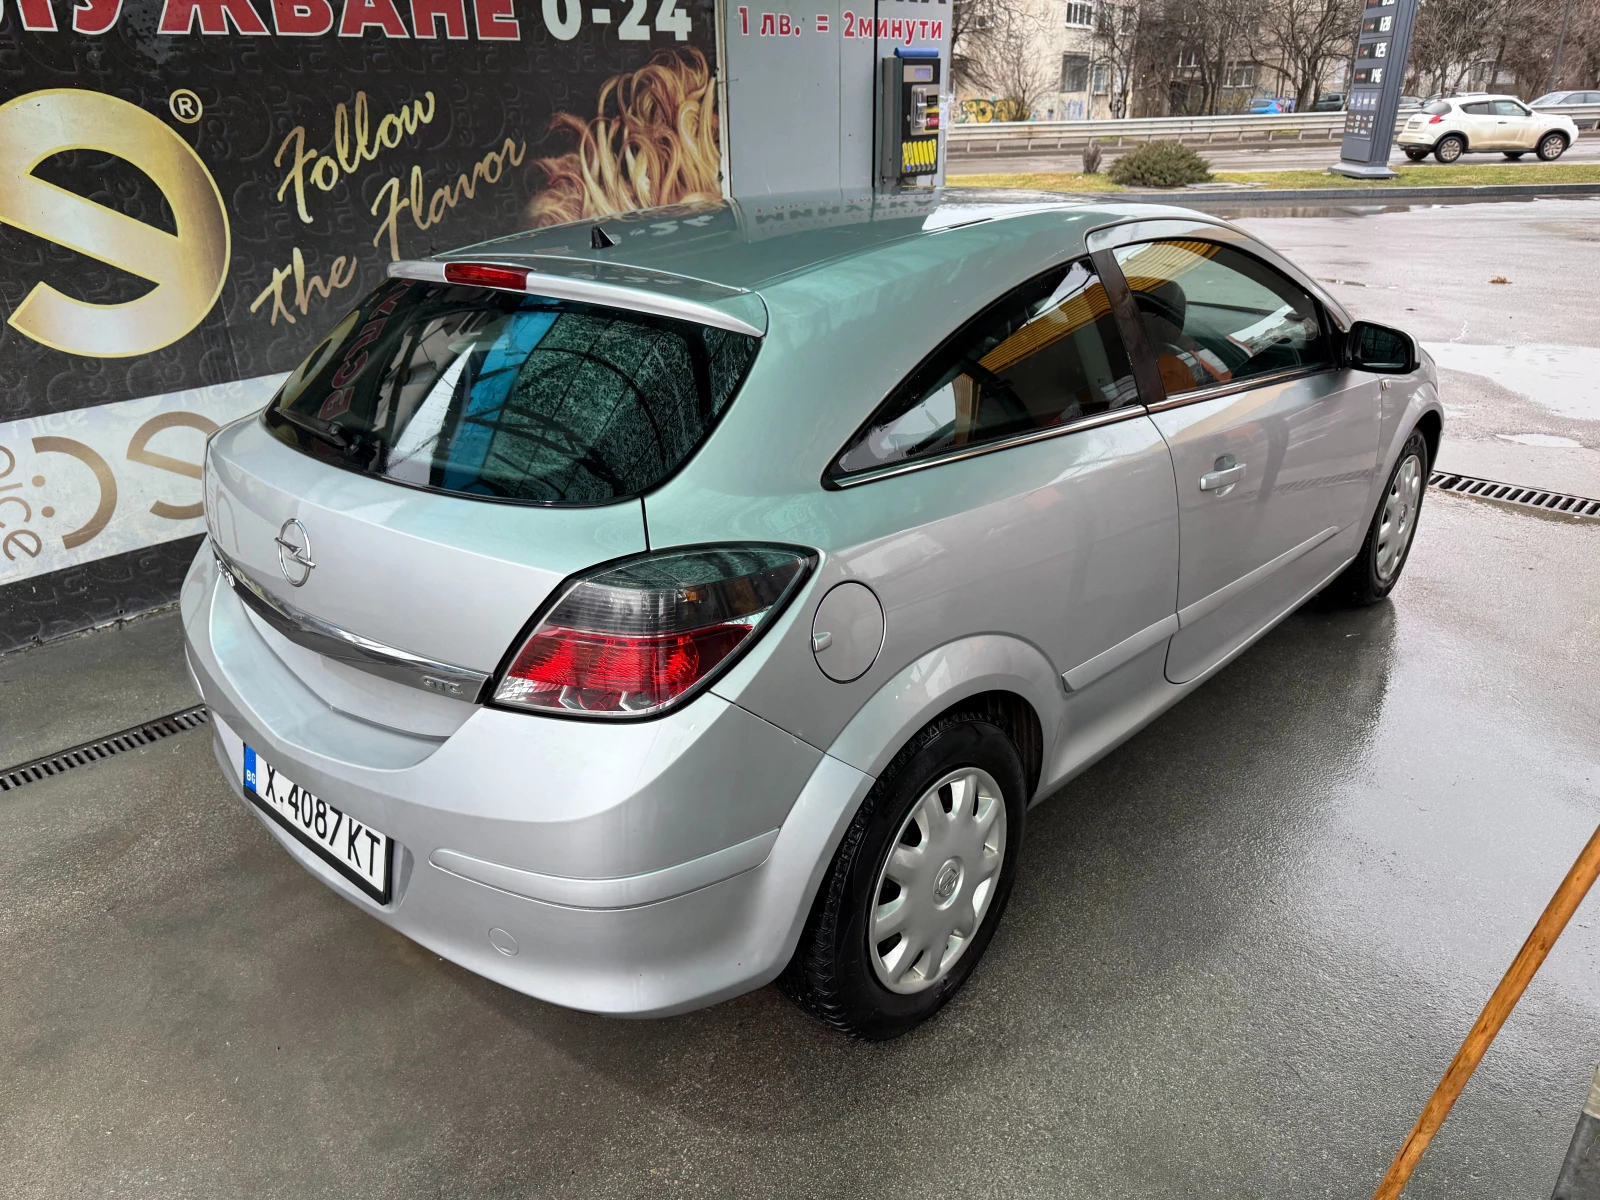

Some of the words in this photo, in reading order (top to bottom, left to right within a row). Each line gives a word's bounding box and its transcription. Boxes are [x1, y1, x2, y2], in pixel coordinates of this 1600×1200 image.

[542, 0, 694, 41] 0-24
[738, 6, 749, 35] 1
[274, 90, 435, 224] Follow
[249, 246, 358, 327] the
[370, 137, 527, 260] Flavor
[246, 769, 256, 785] BG
